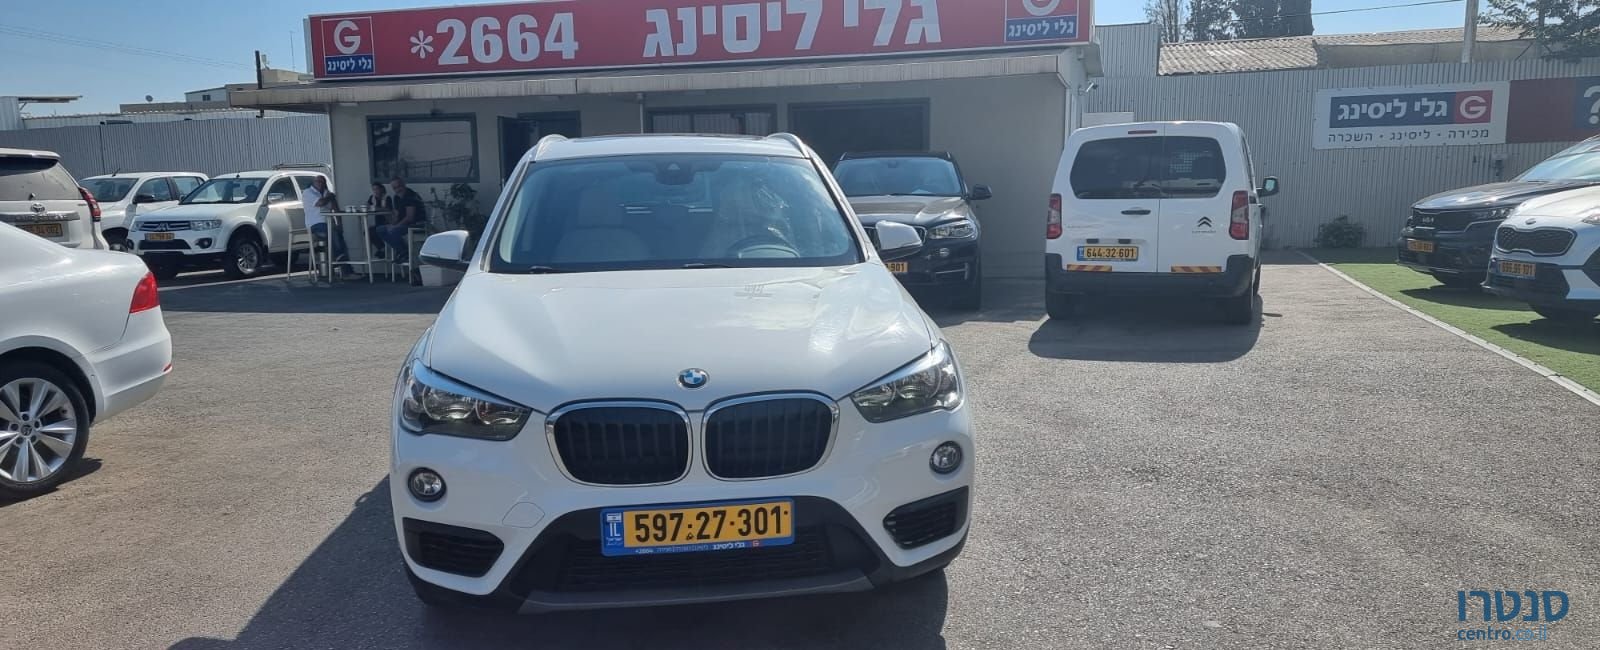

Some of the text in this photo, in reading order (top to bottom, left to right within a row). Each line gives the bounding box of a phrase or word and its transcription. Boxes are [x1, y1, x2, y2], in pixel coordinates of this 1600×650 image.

[333, 20, 361, 55] G
[643, 0, 942, 58] גלי ליסינג
[1008, 19, 1074, 37] גלי ליסינג
[327, 56, 372, 71] גלי ליסינג
[1337, 98, 1448, 121] גלי ליסינג
[1459, 95, 1487, 119] G
[1328, 128, 1489, 143] מכירה ליסינג השכרה
[609, 522, 621, 537] IL
